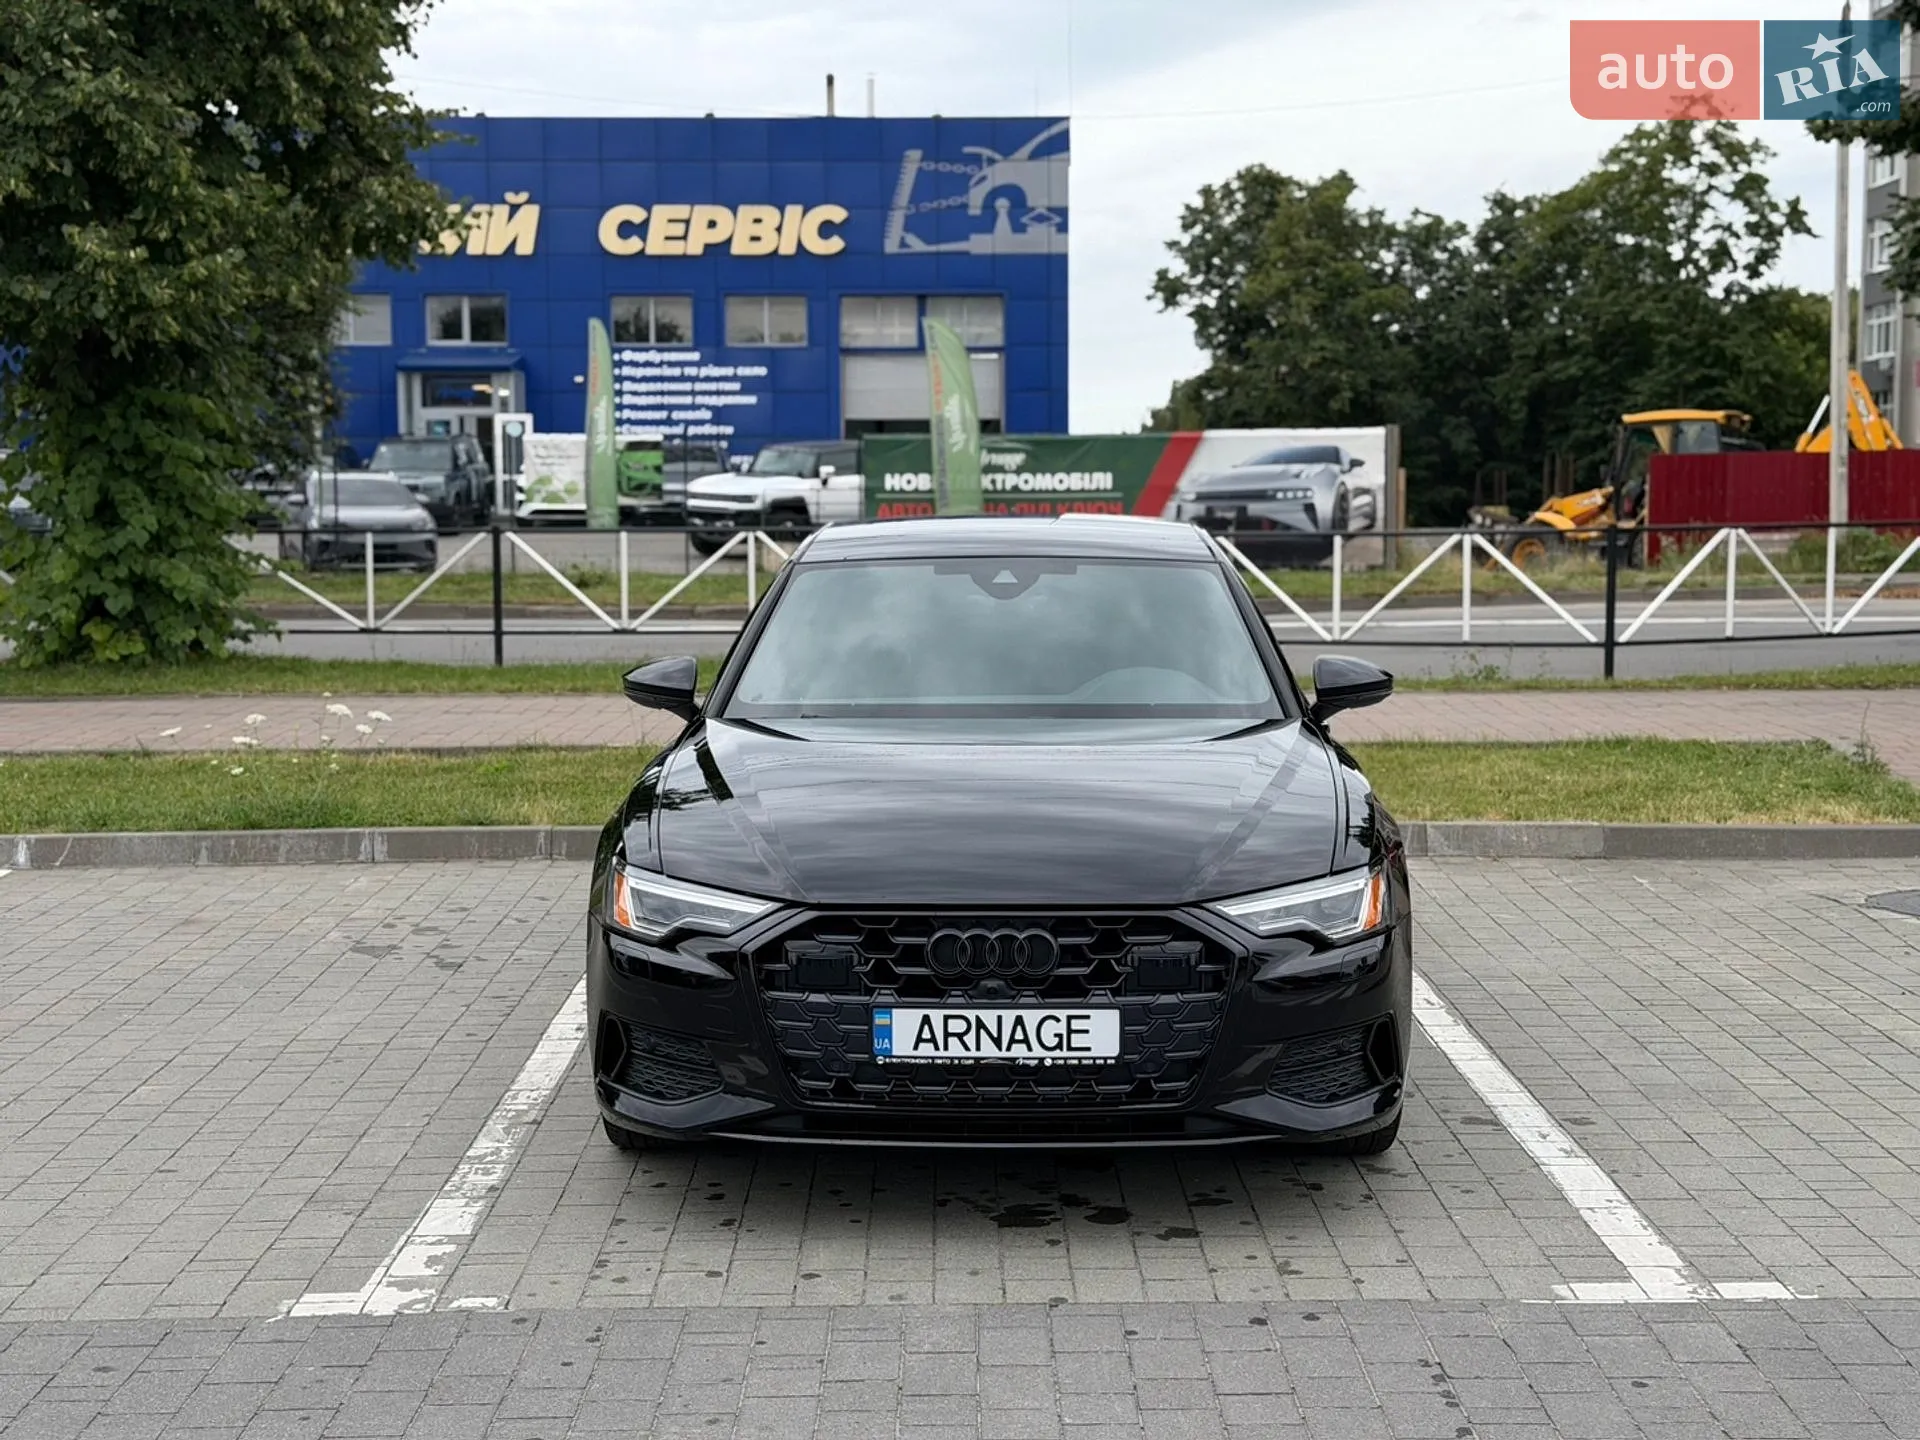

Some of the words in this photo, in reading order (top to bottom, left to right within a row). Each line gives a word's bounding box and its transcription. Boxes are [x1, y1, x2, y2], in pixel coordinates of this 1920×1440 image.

[598, 203, 849, 256] СЕРВІС
[874, 1038, 891, 1050] UA
[912, 1014, 1092, 1052] ARNAGE
